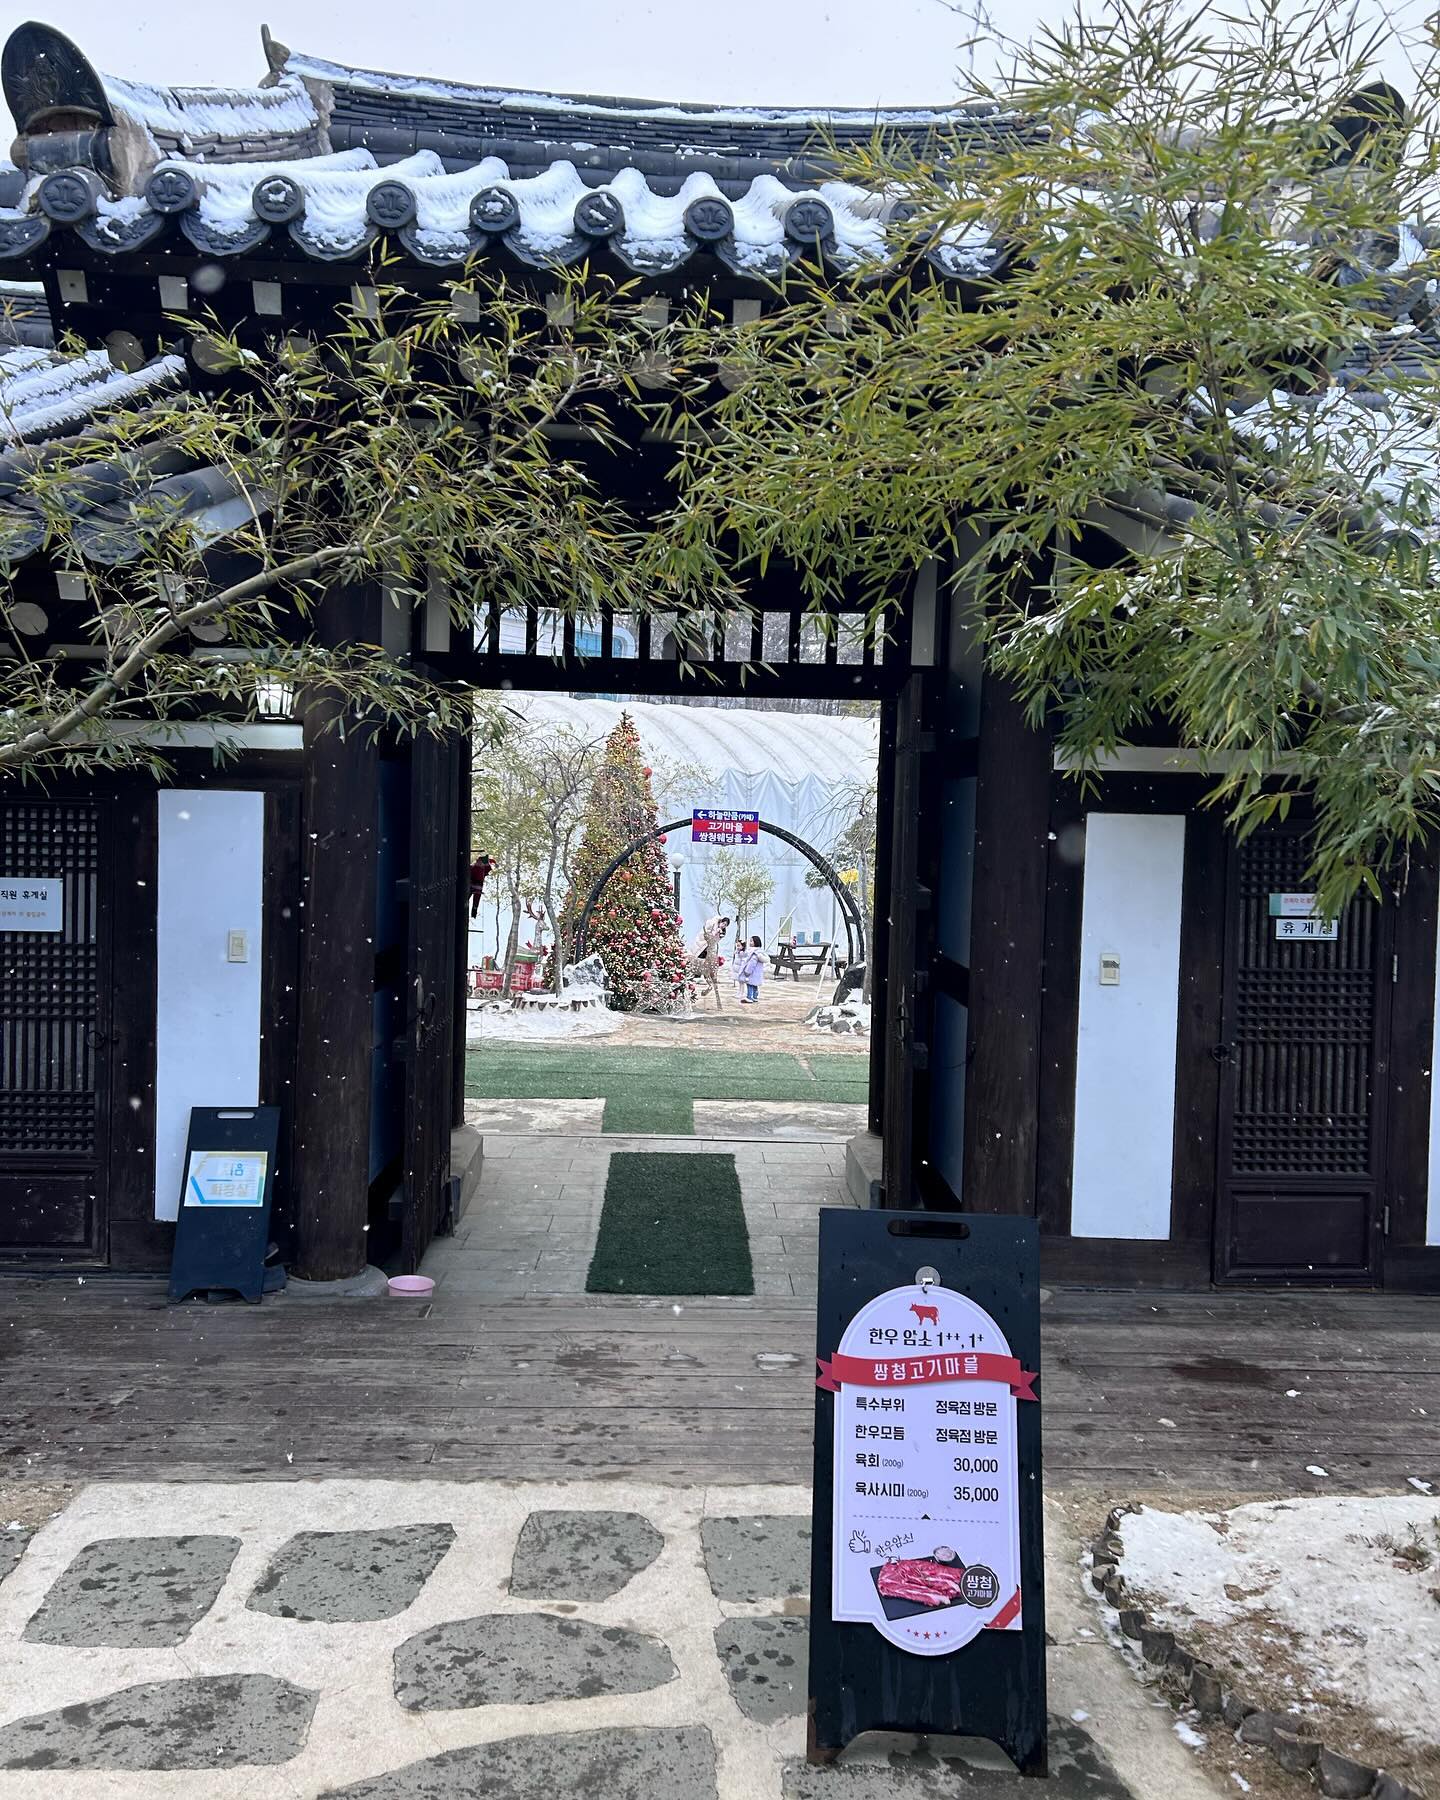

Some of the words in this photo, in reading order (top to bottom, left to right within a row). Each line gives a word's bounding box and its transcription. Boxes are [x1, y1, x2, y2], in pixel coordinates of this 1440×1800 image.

[708, 821, 744, 832] 고기마을
[0, 890, 17, 900] 직원
[22, 890, 48, 901] 휴게실
[869, 1328, 898, 1345] 한우
[903, 1329, 933, 1347] 암소
[873, 1354, 979, 1381] 쌍청고기마을
[855, 1396, 905, 1412] 특수부위
[935, 1400, 971, 1416] 정육점
[973, 1401, 998, 1417] 방문
[935, 1428, 971, 1444] 정육점
[974, 1429, 998, 1445] 방문
[855, 1453, 880, 1468] 육회
[881, 1458, 904, 1469] (200g)
[953, 1457, 999, 1473] 30,000
[855, 1481, 905, 1497] 육사시미
[906, 1487, 929, 1499] (200g)
[953, 1486, 999, 1502] 35,000
[966, 1575, 993, 1589] 쌍청
